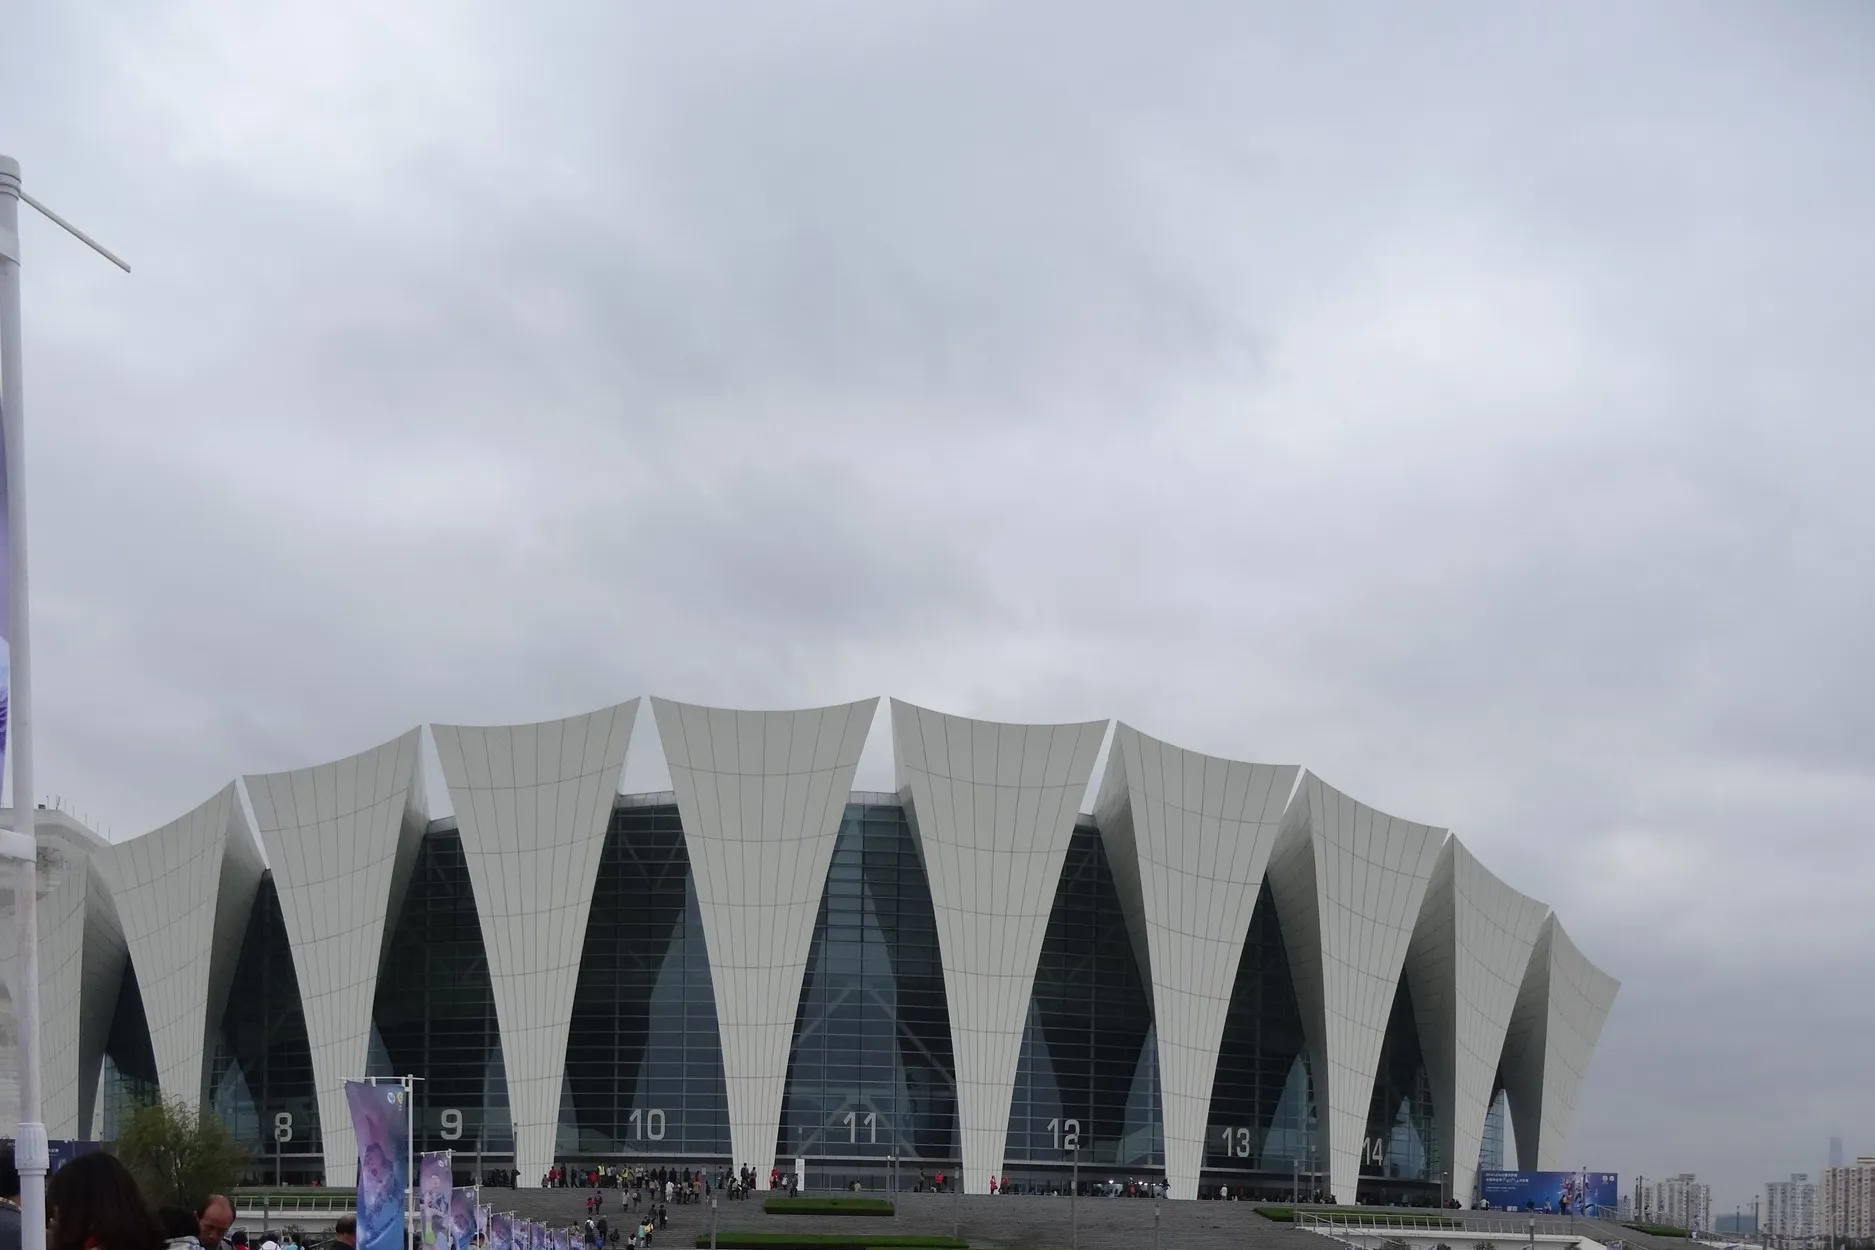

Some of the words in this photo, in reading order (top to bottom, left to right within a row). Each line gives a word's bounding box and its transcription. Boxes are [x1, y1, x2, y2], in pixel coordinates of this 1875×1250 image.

[274, 1112, 293, 1142] 8
[440, 1108, 463, 1140] 9
[628, 1108, 666, 1141] 10
[843, 1111, 877, 1144] 11
[1046, 1118, 1080, 1150] 12
[1222, 1127, 1251, 1158] 13
[1362, 1136, 1383, 1166] 14
